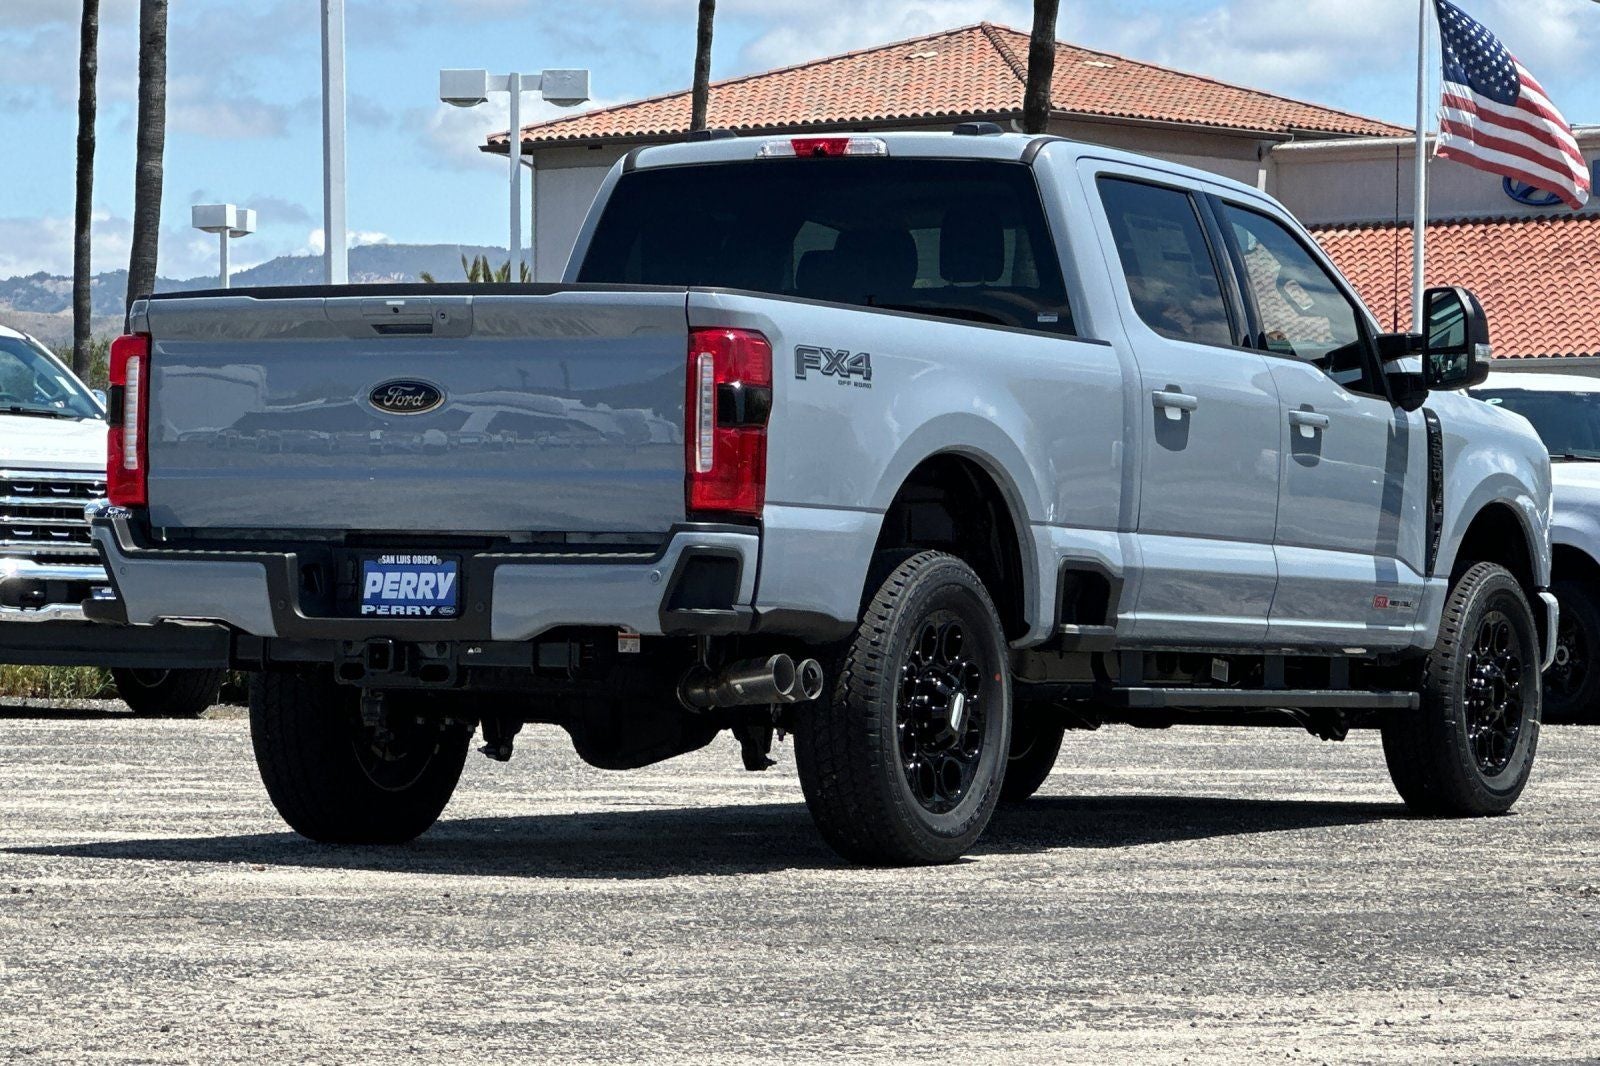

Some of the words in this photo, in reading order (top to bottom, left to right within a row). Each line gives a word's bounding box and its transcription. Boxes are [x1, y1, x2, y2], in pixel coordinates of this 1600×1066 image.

[794, 344, 873, 381] FX4
[854, 381, 872, 389] ROAD
[383, 386, 426, 406] Ford
[381, 555, 395, 565] SAN
[396, 555, 411, 565] LUIS
[412, 555, 437, 565] OBISPO
[363, 572, 456, 600] PERRY
[361, 605, 436, 616] PERRY
